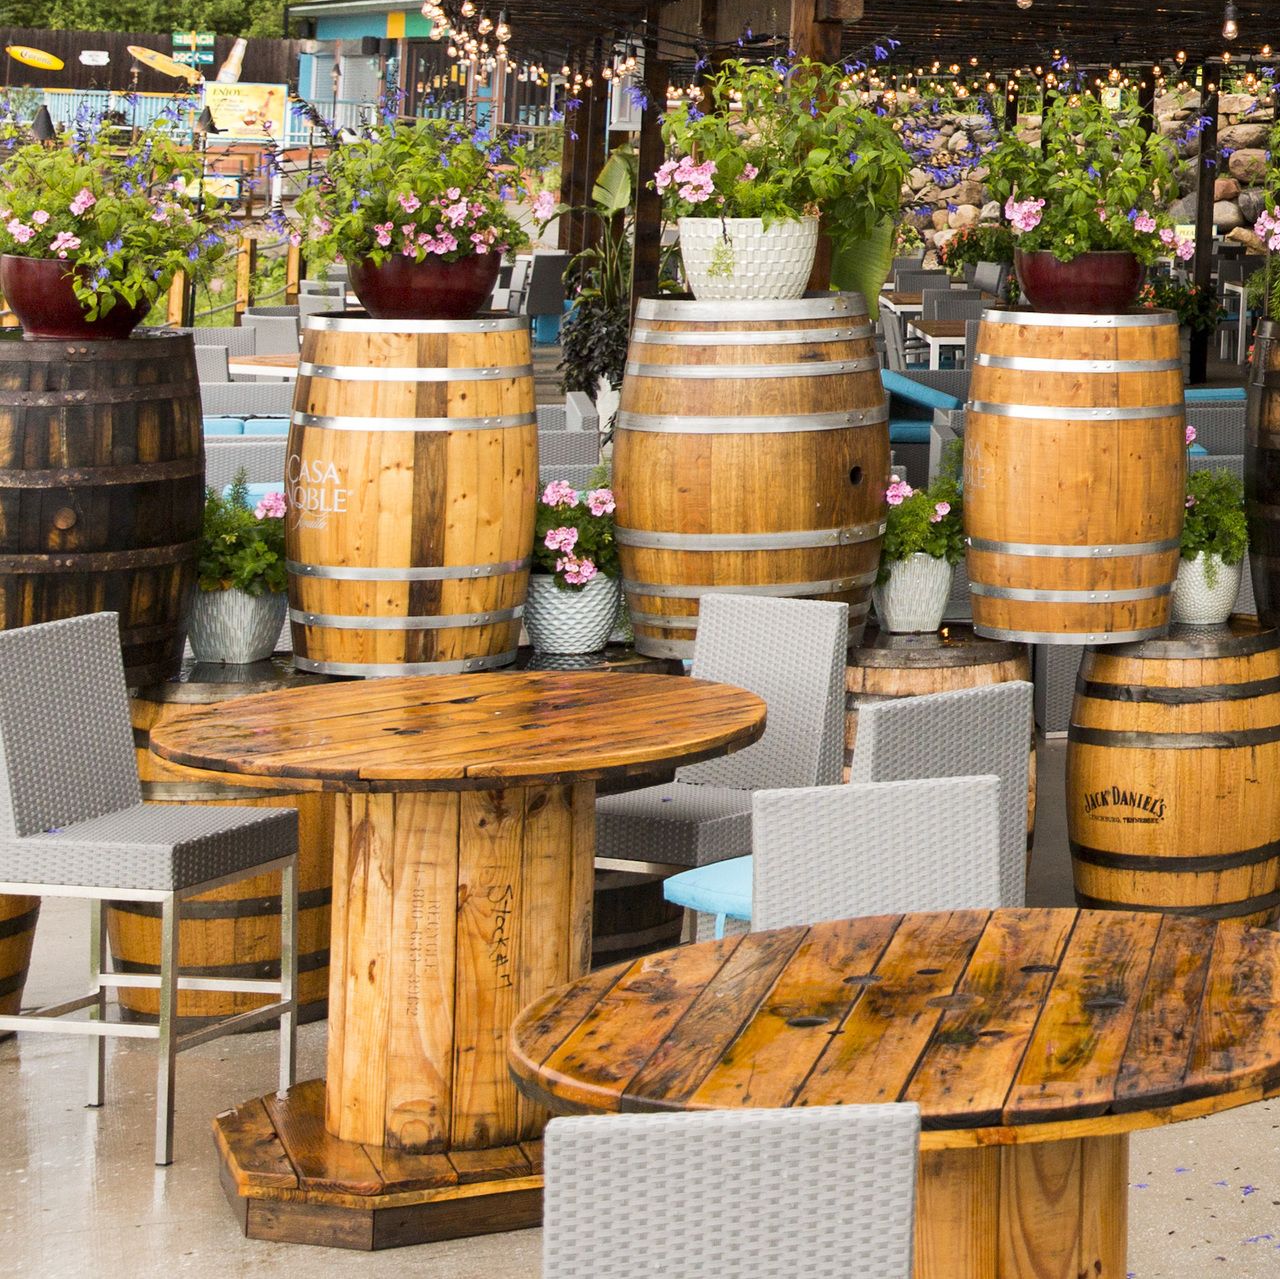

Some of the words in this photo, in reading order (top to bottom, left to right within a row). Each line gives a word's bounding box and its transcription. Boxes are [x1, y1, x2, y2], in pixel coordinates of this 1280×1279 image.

[288, 454, 341, 485] CASA
[287, 482, 347, 513] NOBLE
[1084, 789, 1109, 814] JACK
[1112, 785, 1168, 818] DANIEL'S
[424, 900, 441, 973] RECYCLE
